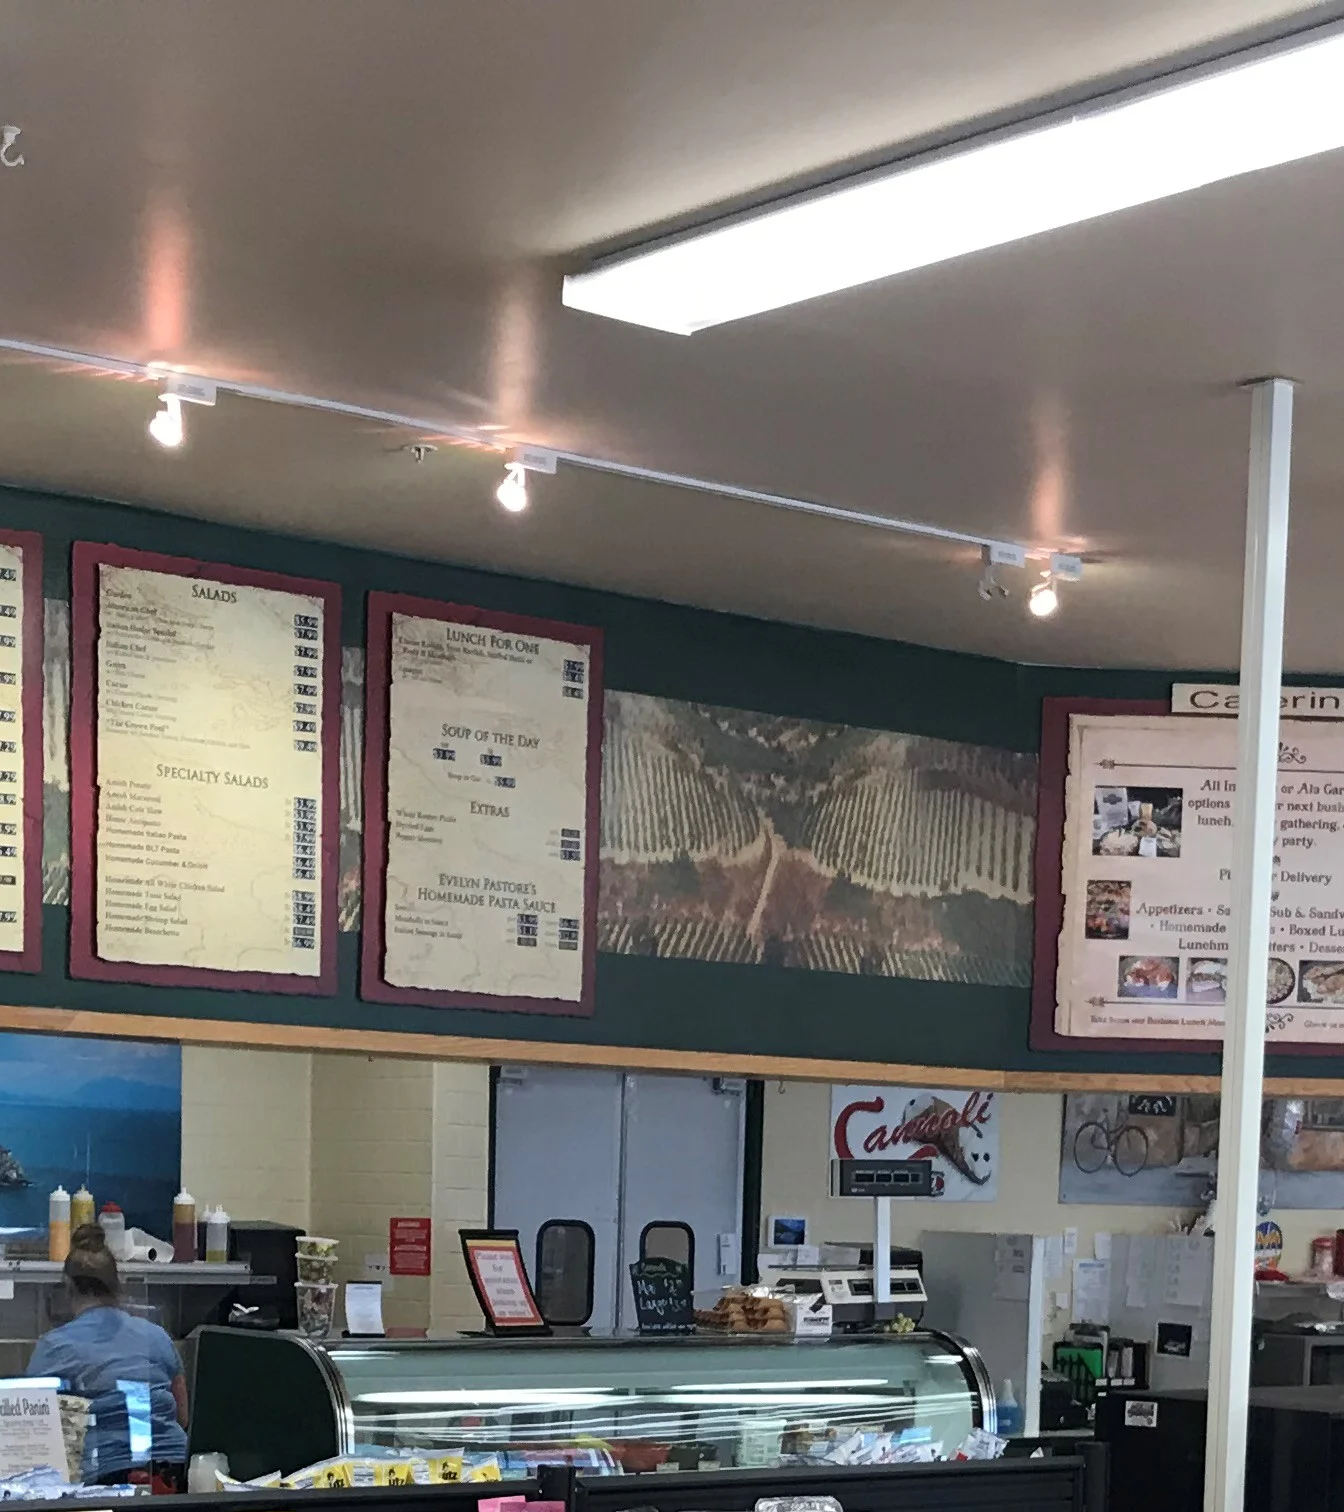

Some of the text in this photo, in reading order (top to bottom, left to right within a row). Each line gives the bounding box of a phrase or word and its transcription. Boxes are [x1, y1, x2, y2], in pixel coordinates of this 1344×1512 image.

[192, 585, 237, 603] SALADS
[447, 628, 540, 655] LUNCH FOR ONE
[442, 724, 540, 749] SOUP OF THE DAY
[156, 764, 269, 789] SPECIALTY SALADS
[1200, 780, 1220, 792] All
[1281, 784, 1294, 794] or
[1297, 783, 1320, 795] Ala
[470, 801, 510, 817] EXTRAS
[1188, 799, 1230, 811] options
[1287, 802, 1313, 812] next
[439, 873, 536, 895] EVELYN PASTORE'S
[1280, 871, 1332, 886] Delivery
[418, 887, 556, 913] HOMEMADE PASTA SAUCE
[1136, 903, 1203, 917] Appetizers
[1159, 921, 1226, 934] Homemade
[1289, 925, 1325, 937] Boxed
[834, 1088, 994, 1160] Cannoli
[23, 1398, 50, 1416] Panini
[441, 1471, 458, 1481] utz
